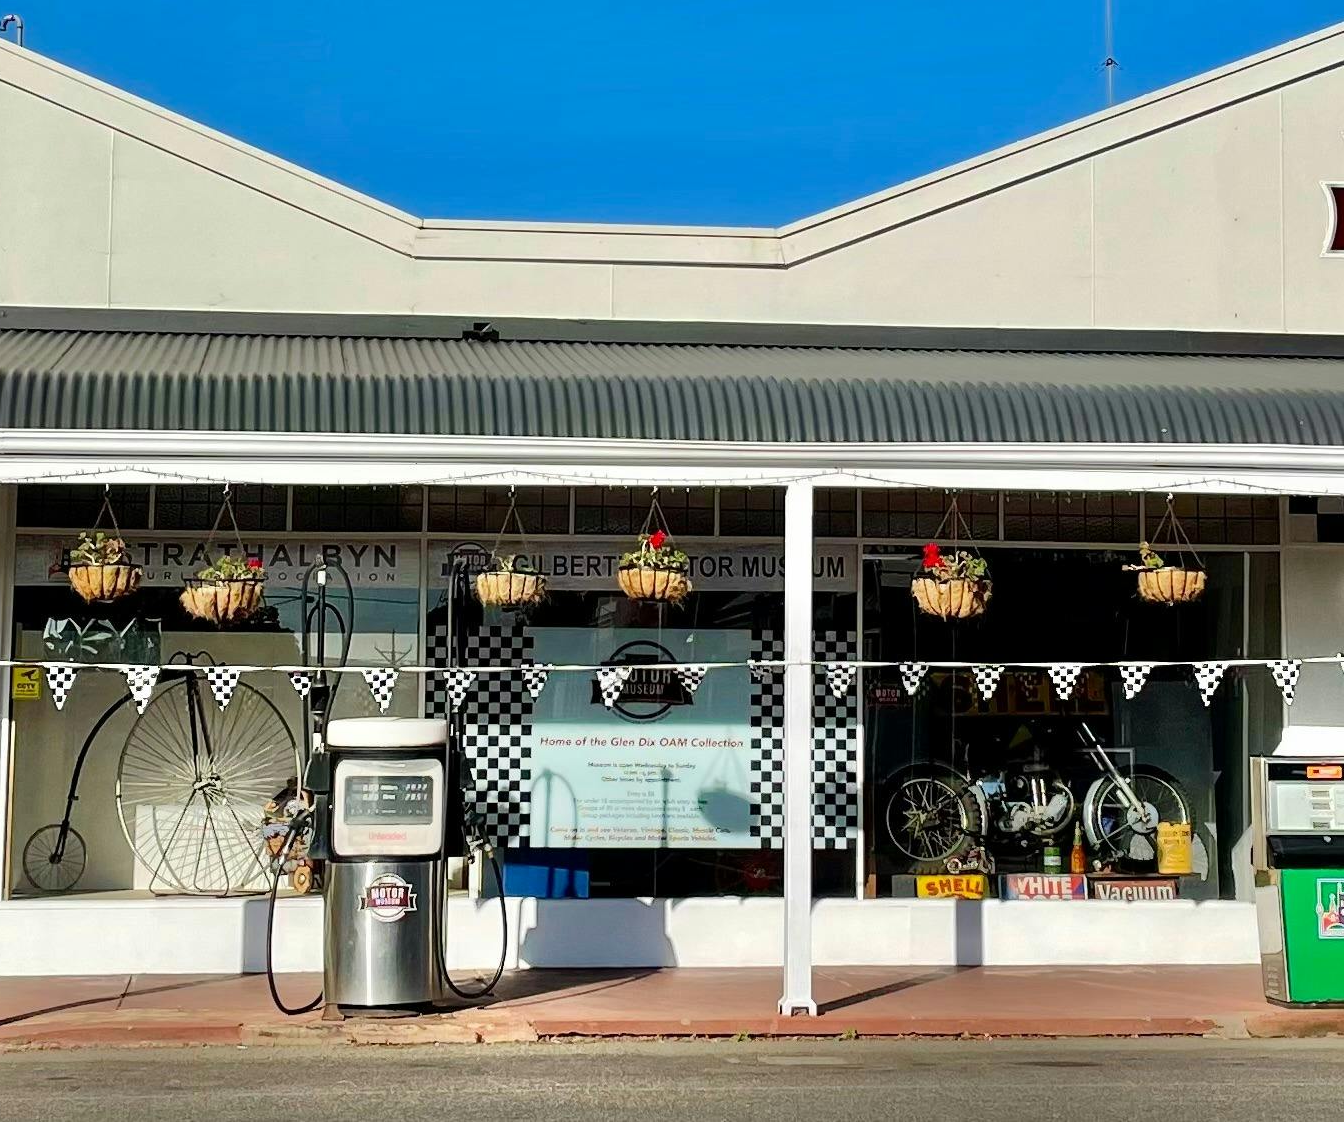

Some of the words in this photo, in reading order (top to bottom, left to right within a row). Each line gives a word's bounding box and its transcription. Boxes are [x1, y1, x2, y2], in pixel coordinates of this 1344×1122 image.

[513, 553, 622, 578] GILBERT'
[742, 556, 845, 578] MUSUM
[540, 737, 572, 747] Home
[575, 737, 588, 747] of
[590, 737, 607, 747] the
[610, 737, 635, 747] Glen
[638, 737, 656, 747] Dix
[659, 738, 688, 748] OAM
[691, 738, 744, 749] Collection
[371, 887, 405, 899] MOTOR
[925, 877, 985, 897] SHELL
[1096, 883, 1175, 900] Vacuum
